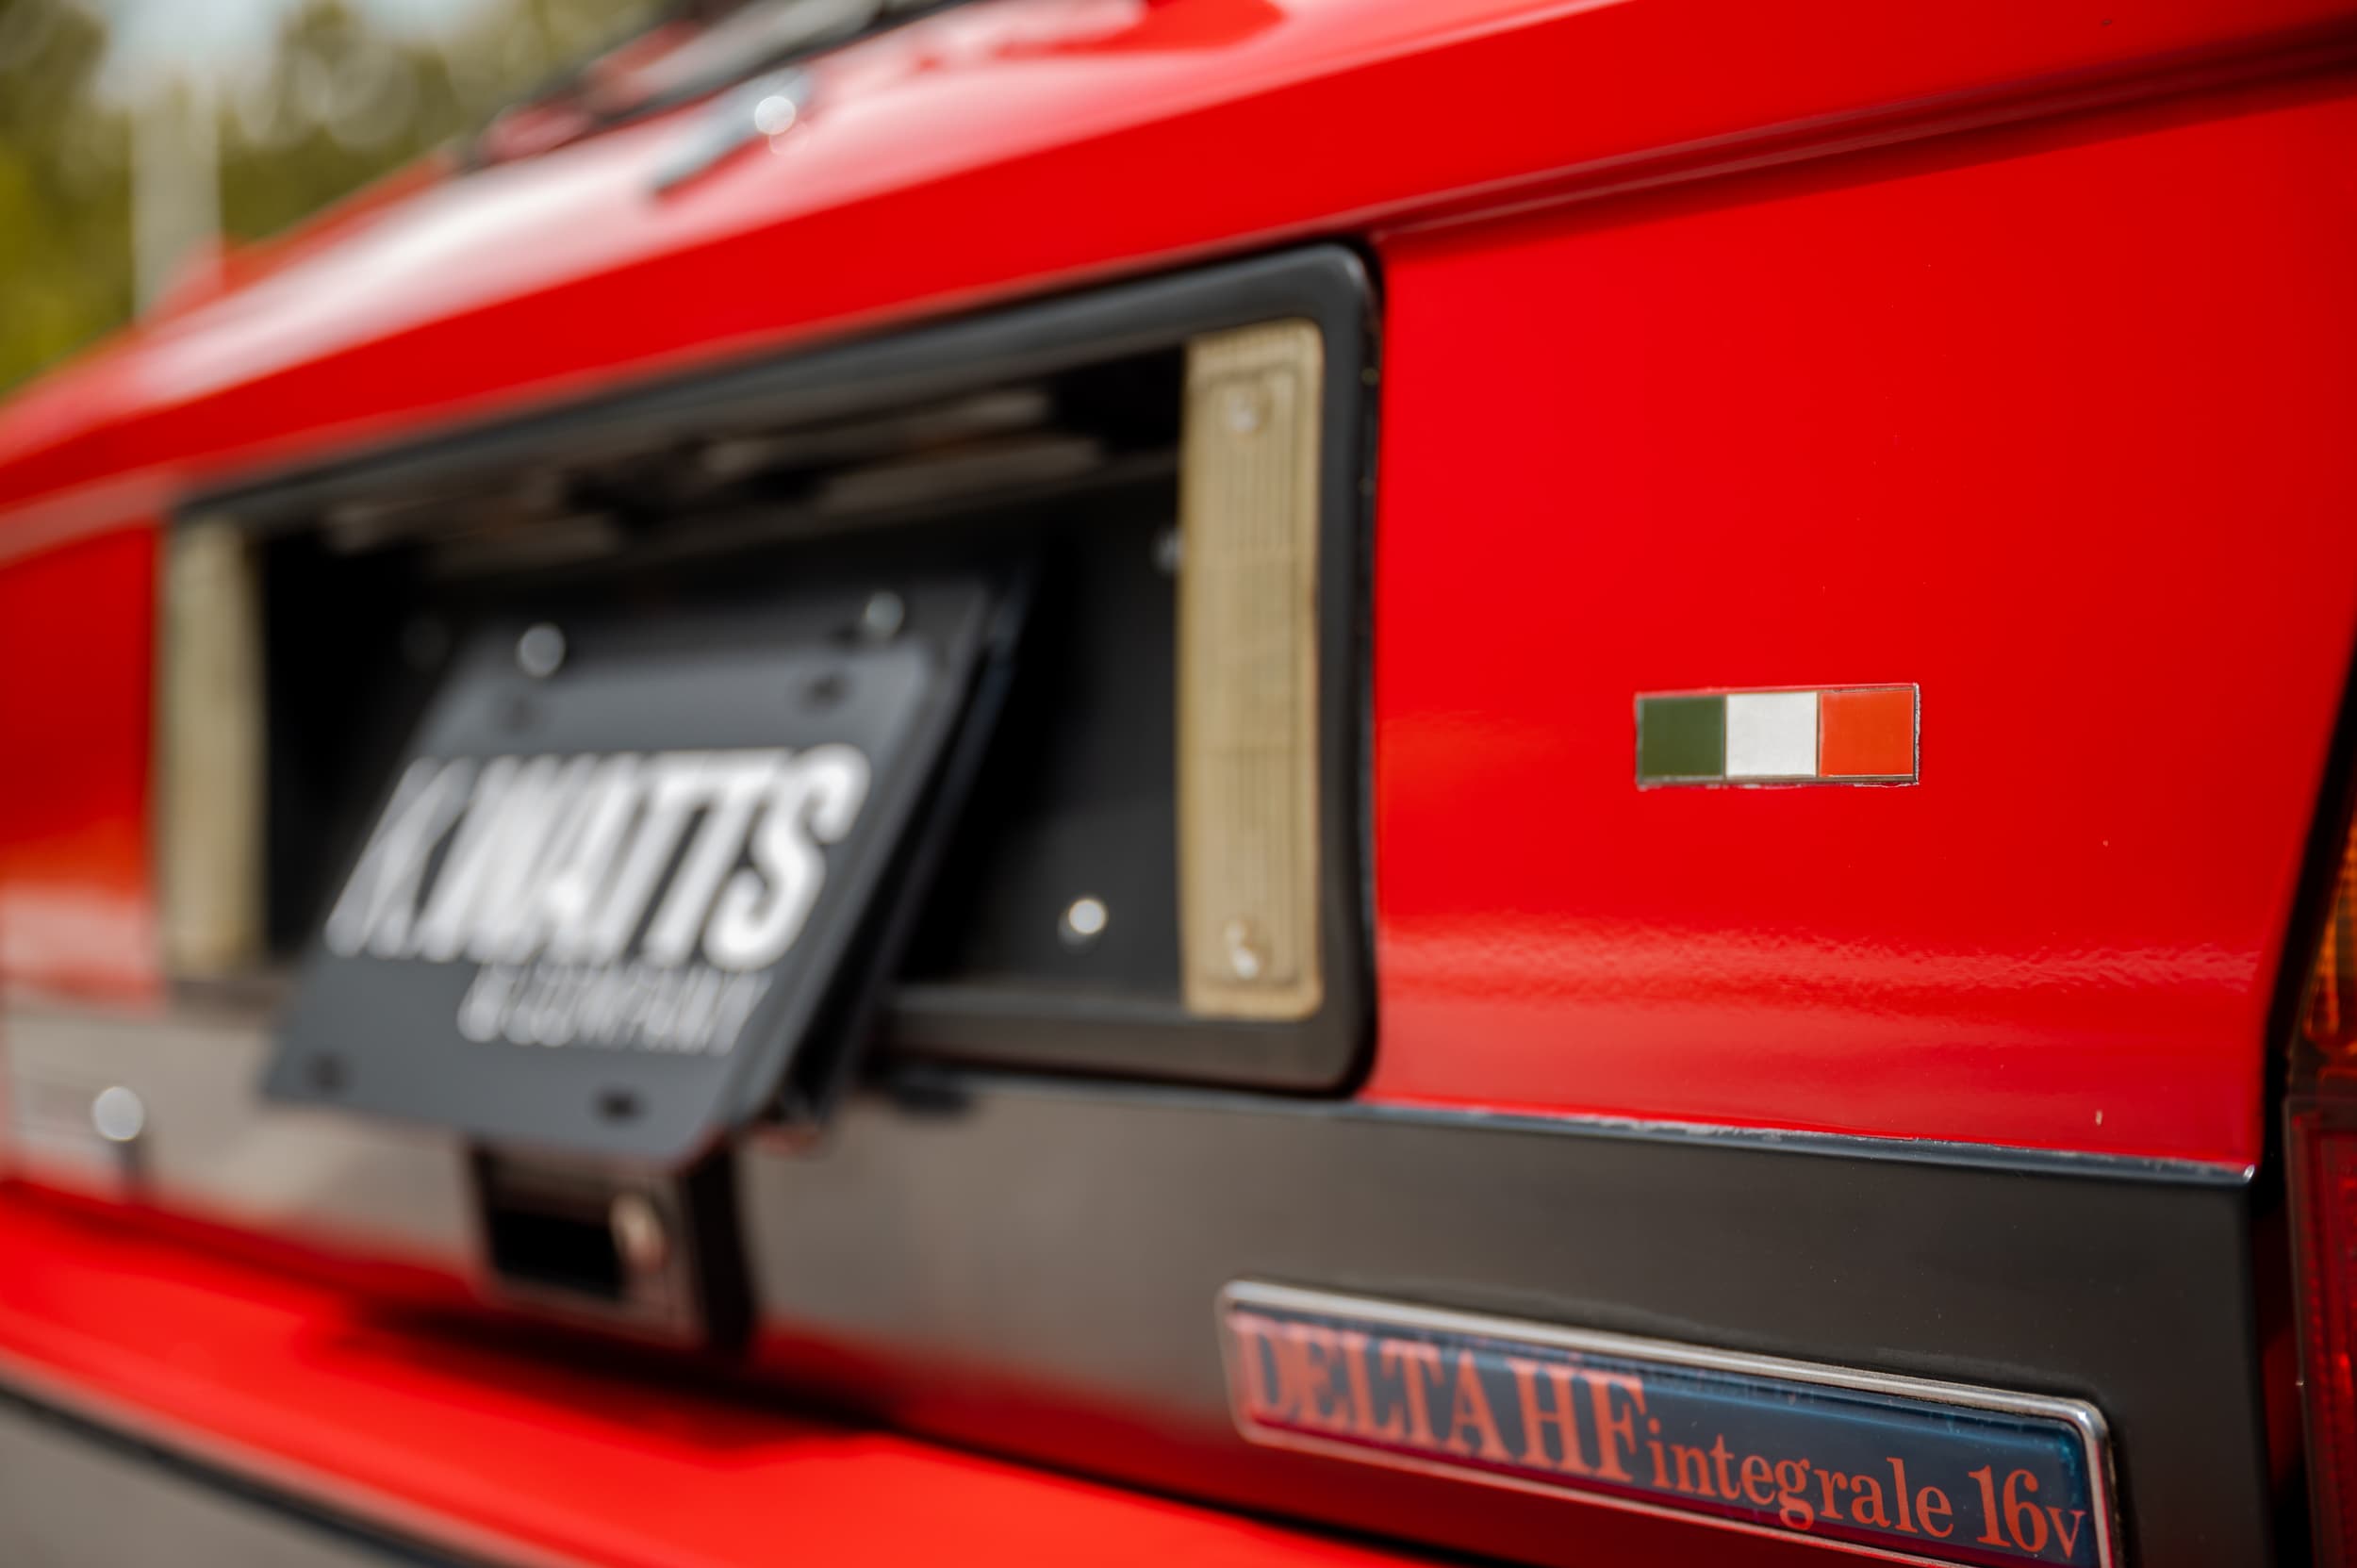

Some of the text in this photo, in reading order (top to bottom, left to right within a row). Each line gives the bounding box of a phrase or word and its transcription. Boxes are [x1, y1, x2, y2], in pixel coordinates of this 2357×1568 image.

[1231, 1312, 1514, 1463] DELTA
[1505, 1356, 1647, 1484] HF
[1645, 1416, 1955, 1532] integrale
